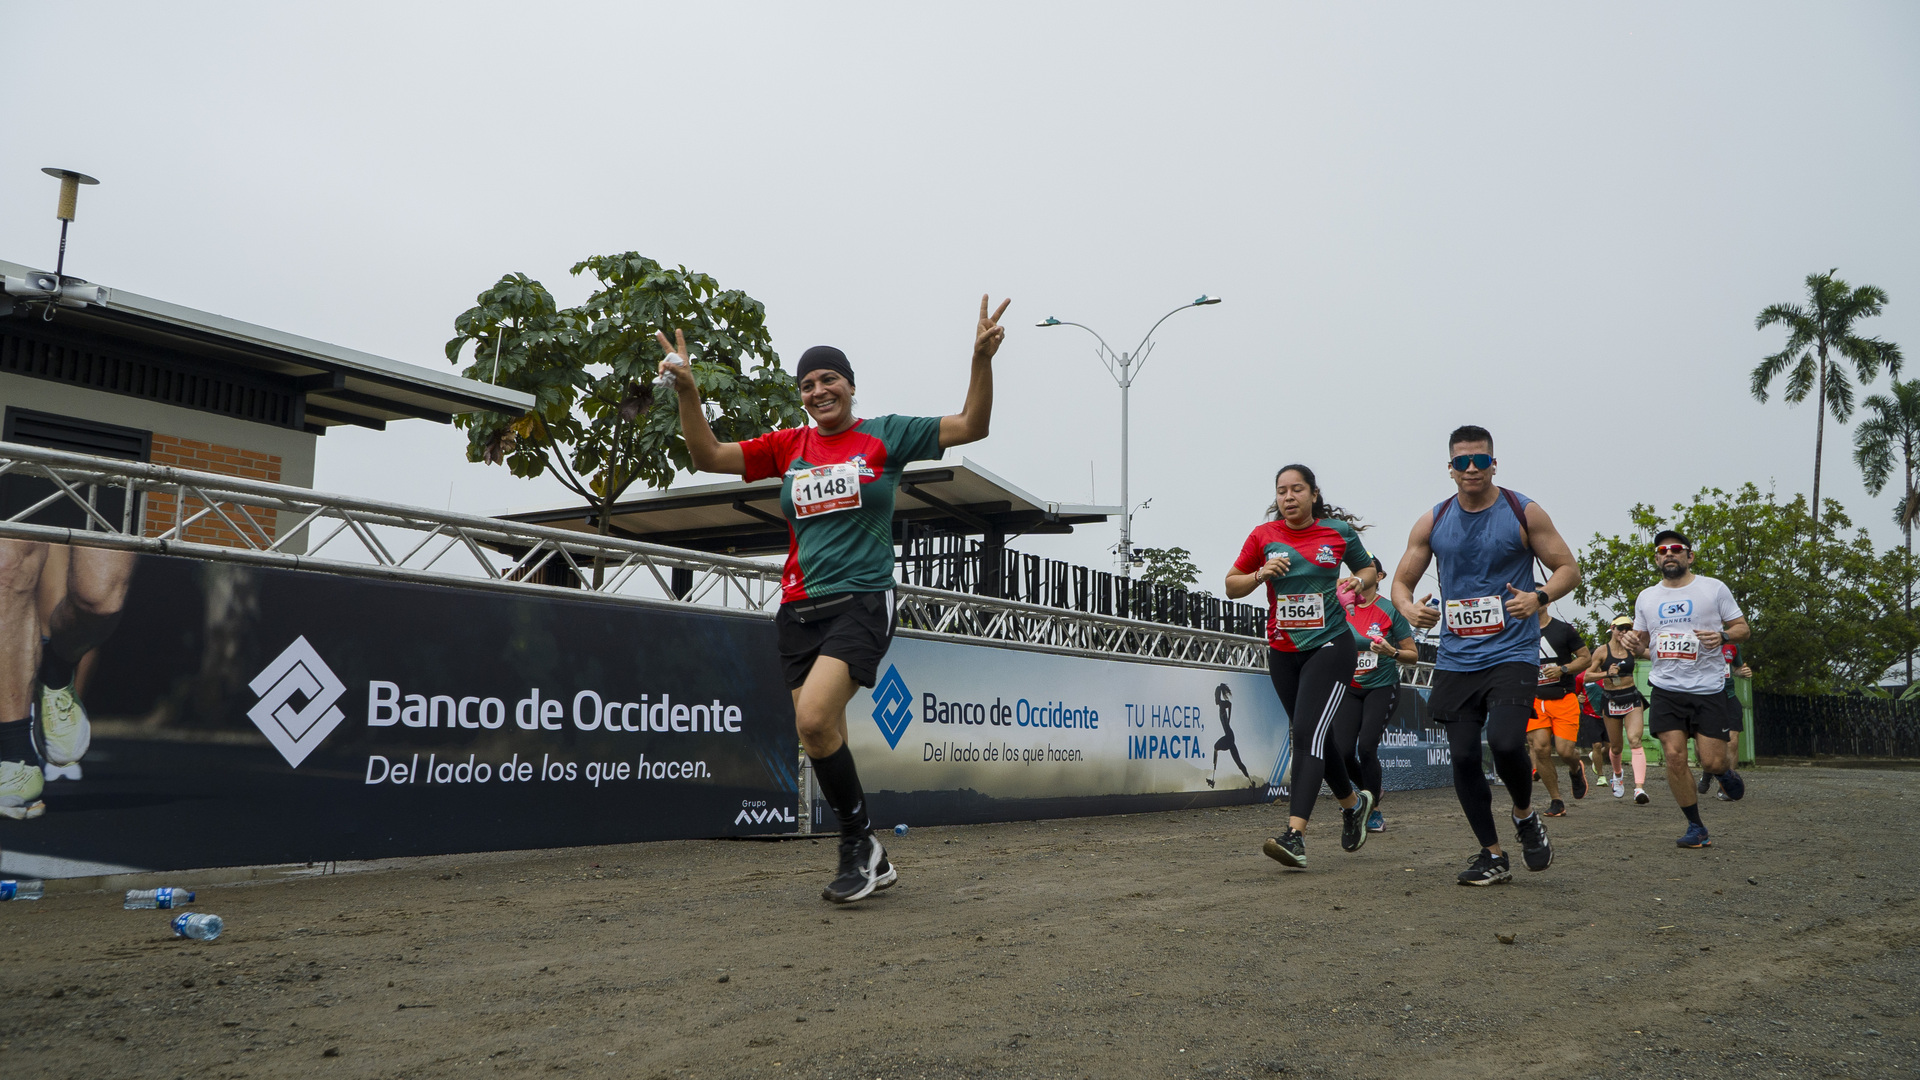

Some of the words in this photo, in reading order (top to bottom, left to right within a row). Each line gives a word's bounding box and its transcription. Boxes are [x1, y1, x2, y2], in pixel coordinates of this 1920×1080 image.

[803, 478, 847, 501] 1148
[1279, 604, 1315, 618] 1564
[1454, 609, 1492, 626] 1657
[1659, 617, 1692, 625] RUNNERS
[1662, 641, 1691, 652] 1312
[1357, 658, 1371, 668] 60
[367, 680, 506, 730] Banco
[515, 687, 564, 731] de
[572, 689, 742, 733] Occidente
[922, 692, 986, 726] Banco
[989, 697, 1012, 727] de
[1015, 698, 1099, 731] Occidente
[1124, 703, 1145, 729] TU
[1151, 704, 1205, 732] HACER,
[1382, 728, 1418, 747] Occidente
[1425, 728, 1435, 745] TU
[923, 742, 947, 763] Del
[950, 742, 980, 763] lado
[983, 742, 999, 762] de
[1002, 742, 1019, 762] los
[1023, 746, 1044, 767] que
[1046, 742, 1084, 762] hacen.
[1127, 734, 1206, 760] IMPACTA.
[365, 753, 419, 786] Del
[426, 753, 492, 785] lado
[498, 753, 534, 783] de
[541, 753, 578, 782] los
[585, 758, 631, 788] que
[637, 753, 712, 781] hacen.
[1385, 759, 1395, 771] que
[1267, 786, 1290, 796] AVAL
[741, 799, 767, 808] Grupo
[734, 806, 796, 826] AVAL
